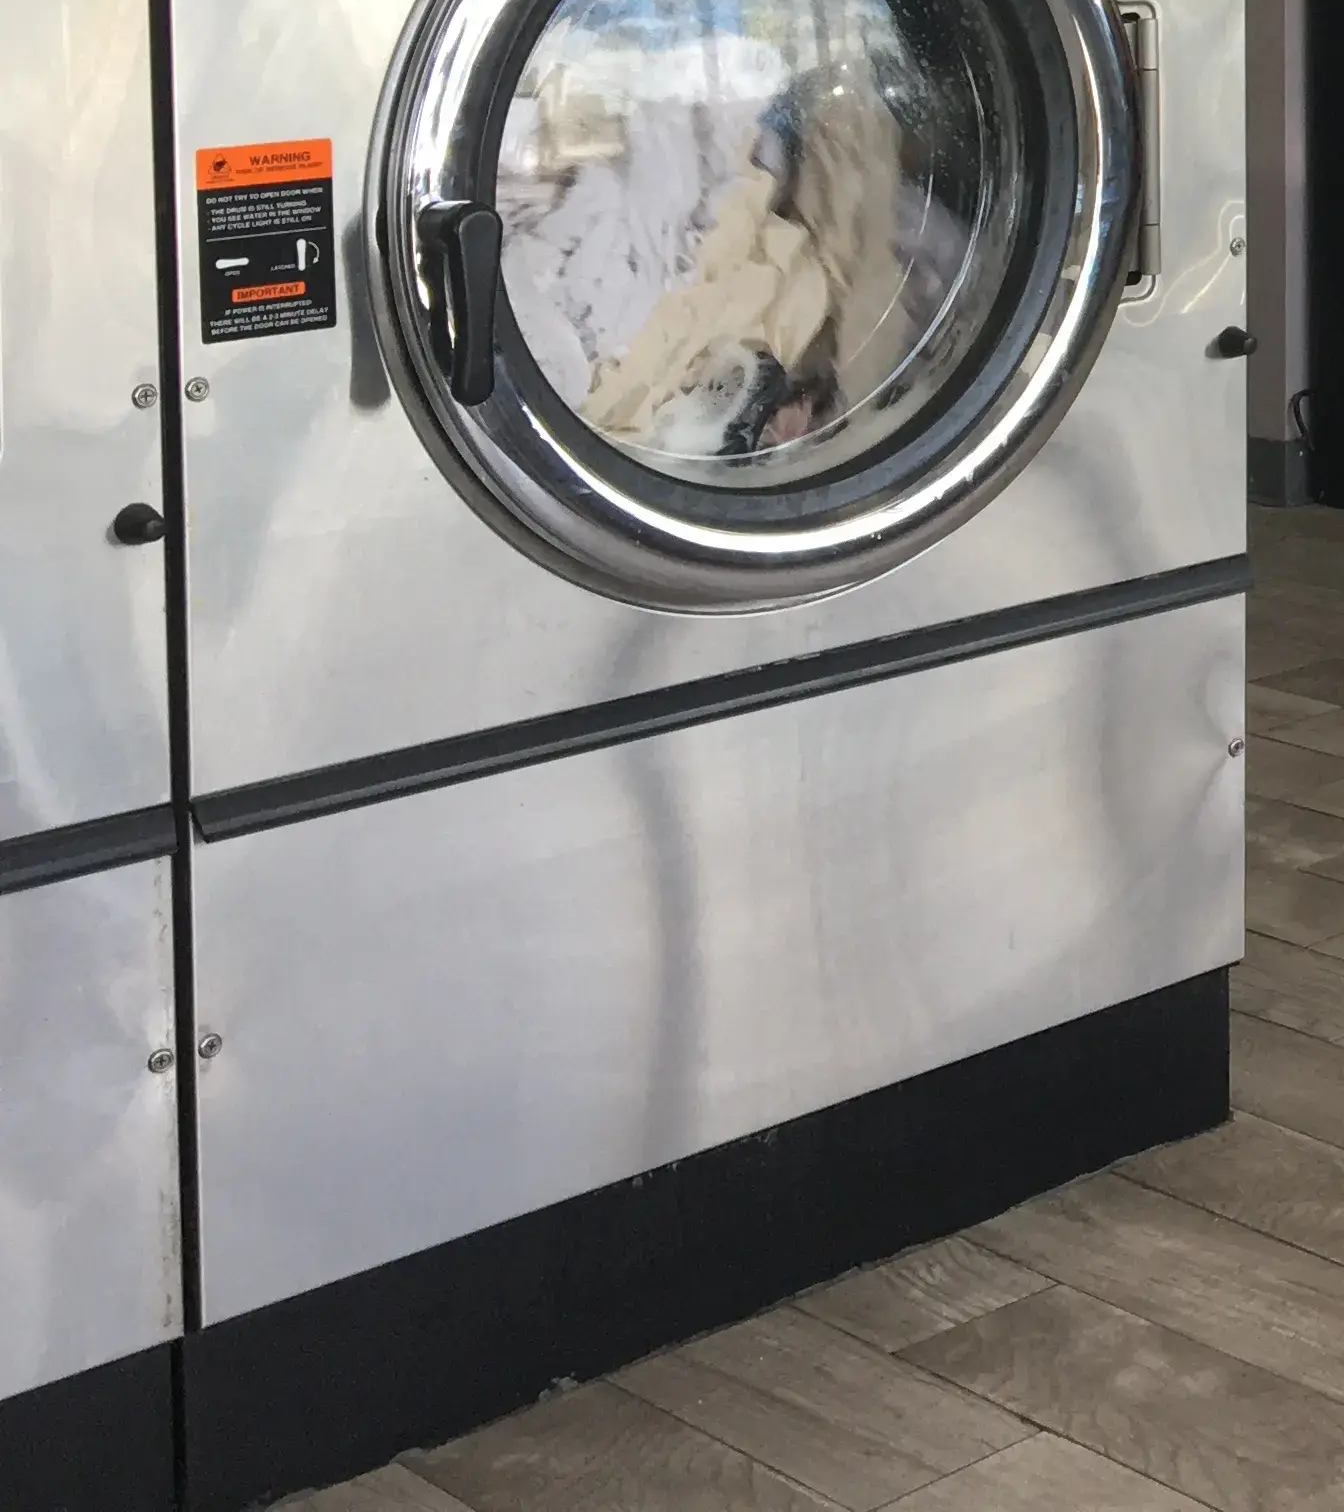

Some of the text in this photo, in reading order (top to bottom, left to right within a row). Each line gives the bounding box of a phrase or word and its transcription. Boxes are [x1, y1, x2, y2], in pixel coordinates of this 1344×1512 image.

[249, 151, 311, 166] WARNING
[218, 195, 232, 203] NOT
[260, 191, 280, 199] OPEN
[256, 203, 275, 211] STILL
[243, 211, 268, 220] WATER
[281, 216, 300, 224] STILL
[237, 284, 299, 300] IMPORTANT
[232, 306, 258, 314] POWER
[306, 307, 328, 315] DELAY
